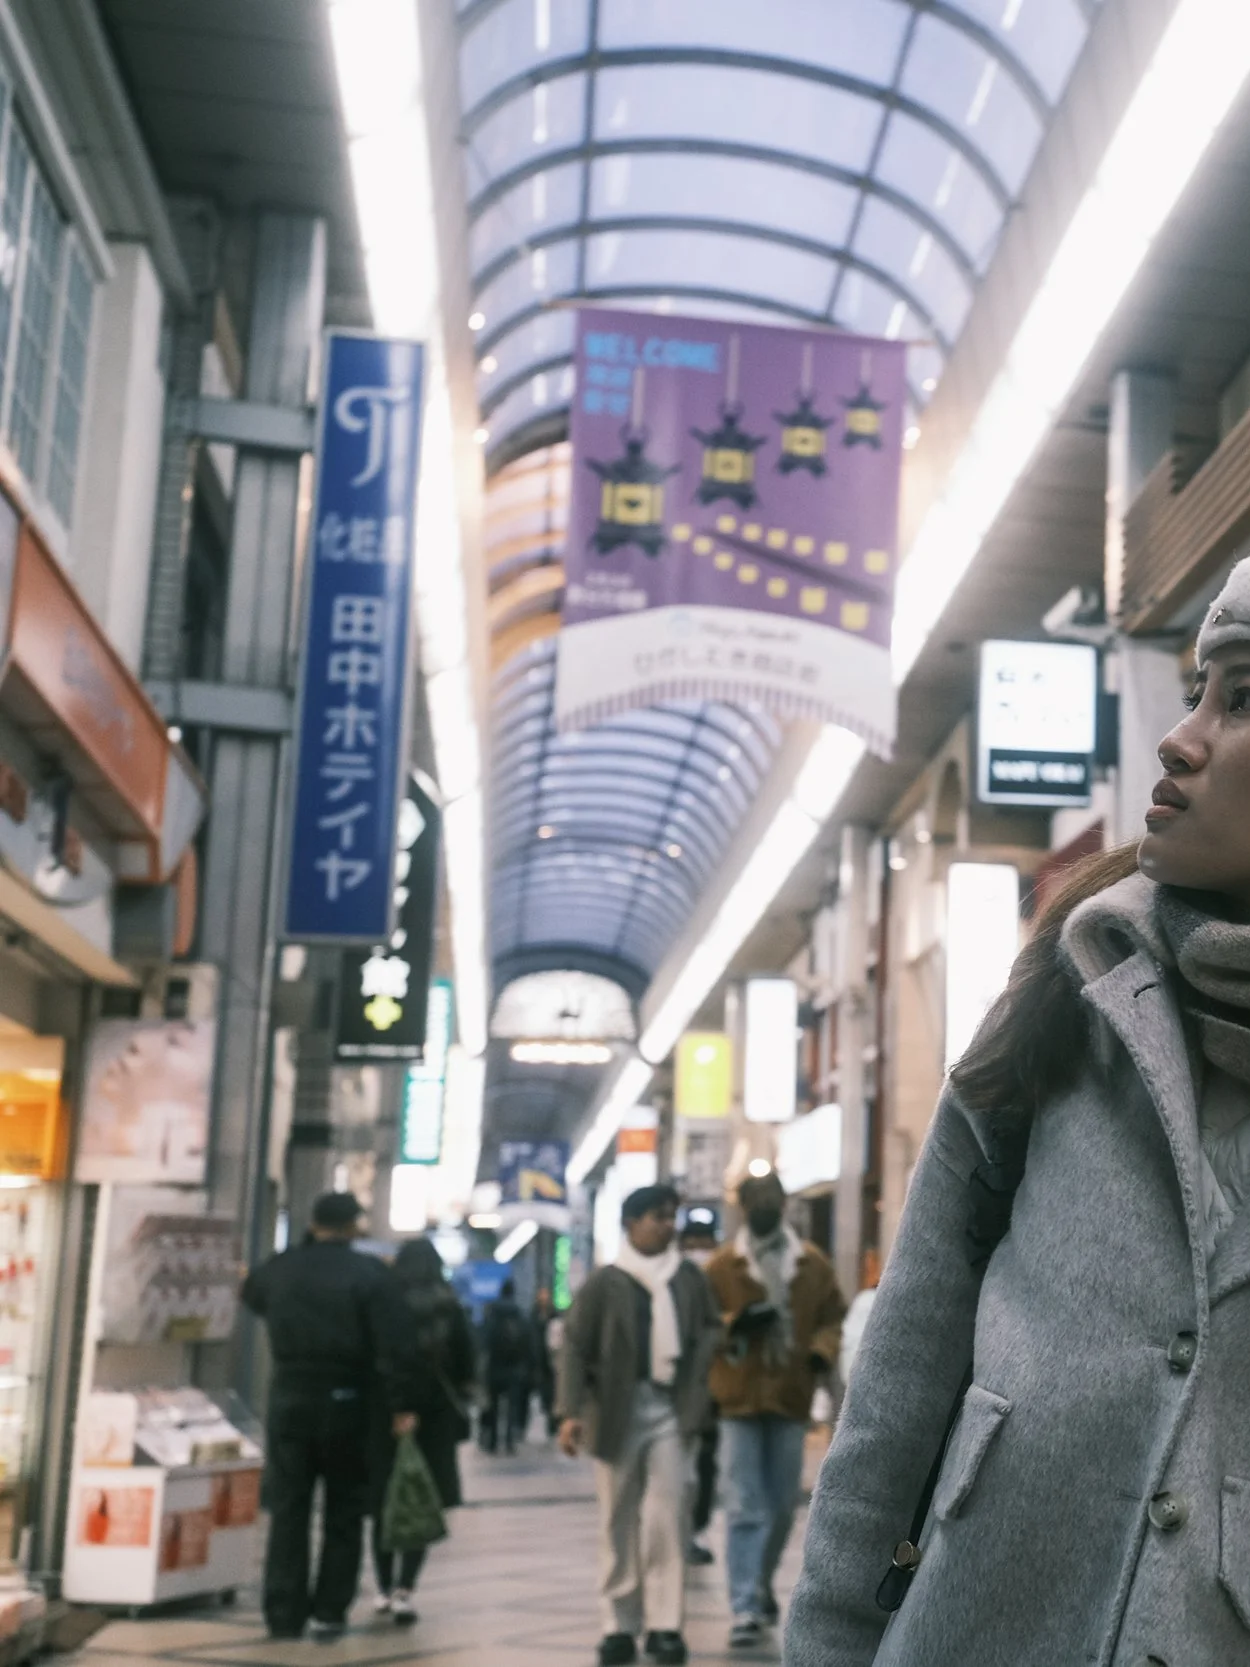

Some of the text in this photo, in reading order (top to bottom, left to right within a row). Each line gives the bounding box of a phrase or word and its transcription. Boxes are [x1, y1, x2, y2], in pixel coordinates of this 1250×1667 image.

[585, 333, 720, 373] WELCOME
[315, 595, 386, 901] 田中ホテイヤ
